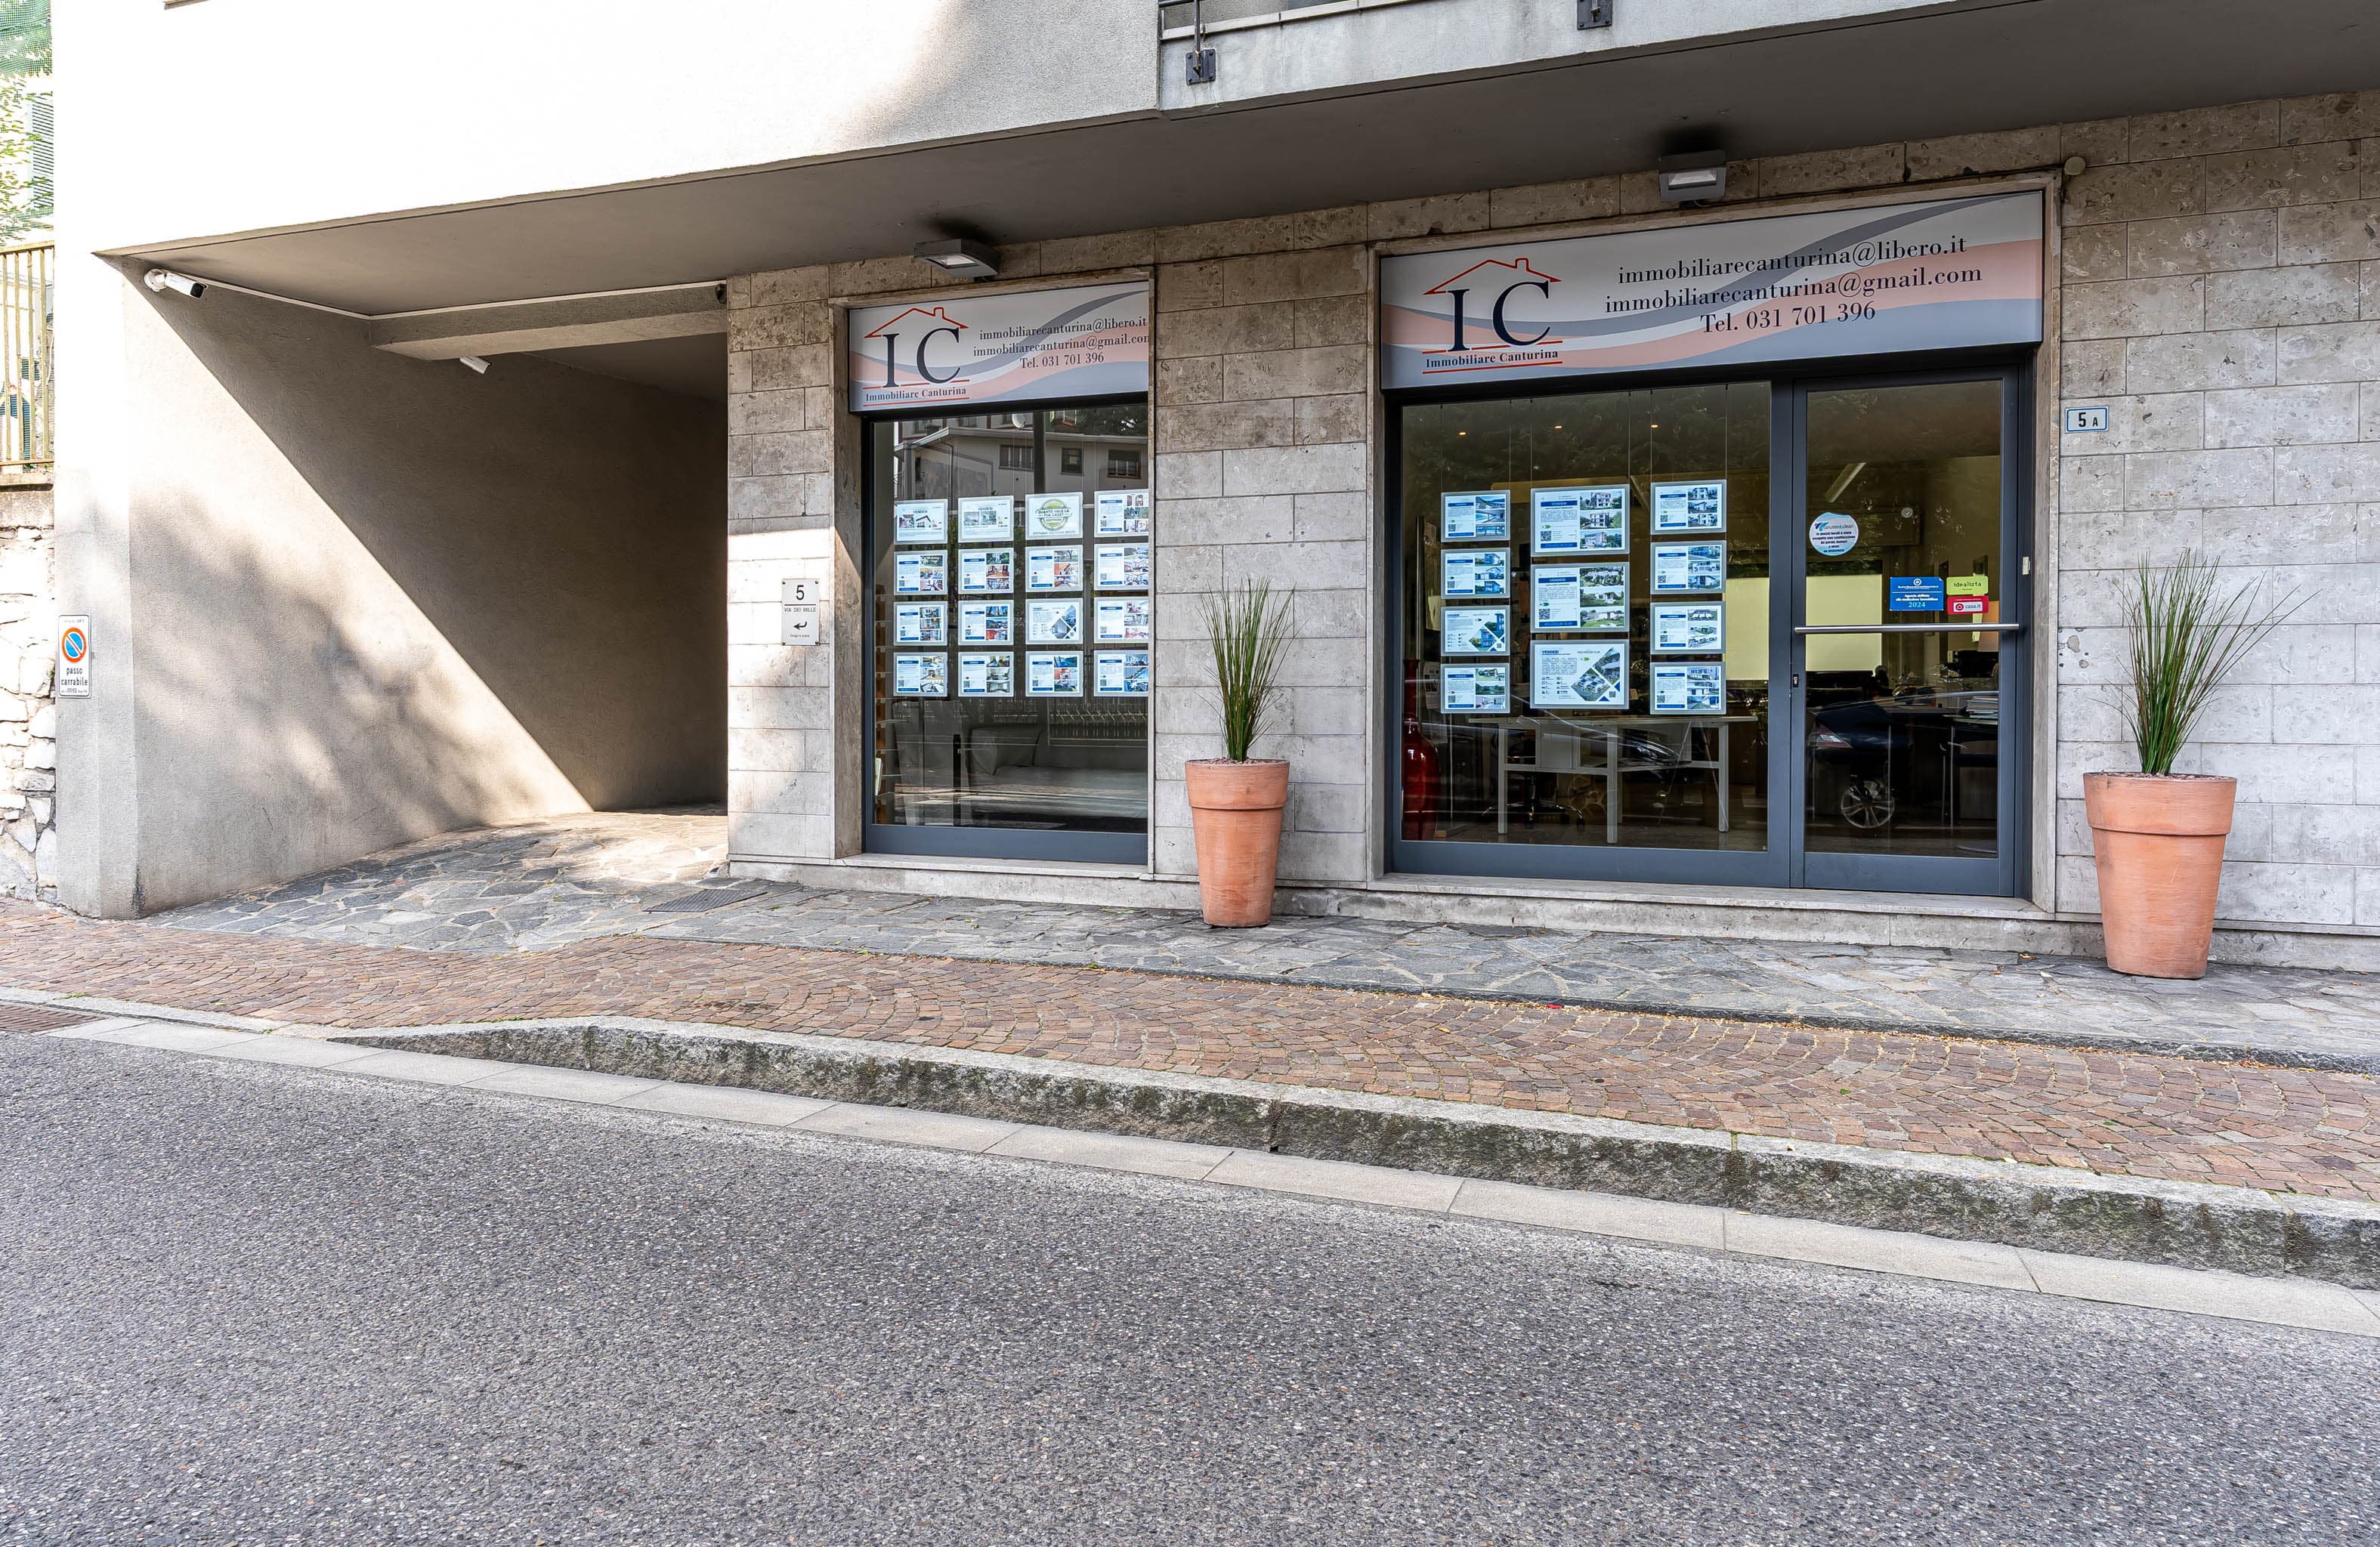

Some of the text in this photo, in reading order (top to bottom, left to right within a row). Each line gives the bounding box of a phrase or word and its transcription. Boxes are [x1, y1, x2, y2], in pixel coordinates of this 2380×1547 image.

[1618, 235, 1967, 284] immobiliarecanturina@libero.it
[1605, 266, 1983, 313] immobiliarecanturina@gmail.com
[1700, 300, 1876, 332] Tel. 031 701 396
[978, 316, 1148, 340] immobiliarecanturina@libero.it
[1020, 351, 1105, 369] Tel. 031 701 396
[1425, 348, 1559, 368] Immobiliare Canturina
[865, 386, 967, 402] Immobiliare Canturina
[2078, 412, 2098, 428] 5 A
[796, 585, 805, 601] 5
[66, 668, 82, 676] passo
[60, 677, 88, 686] carrabile
